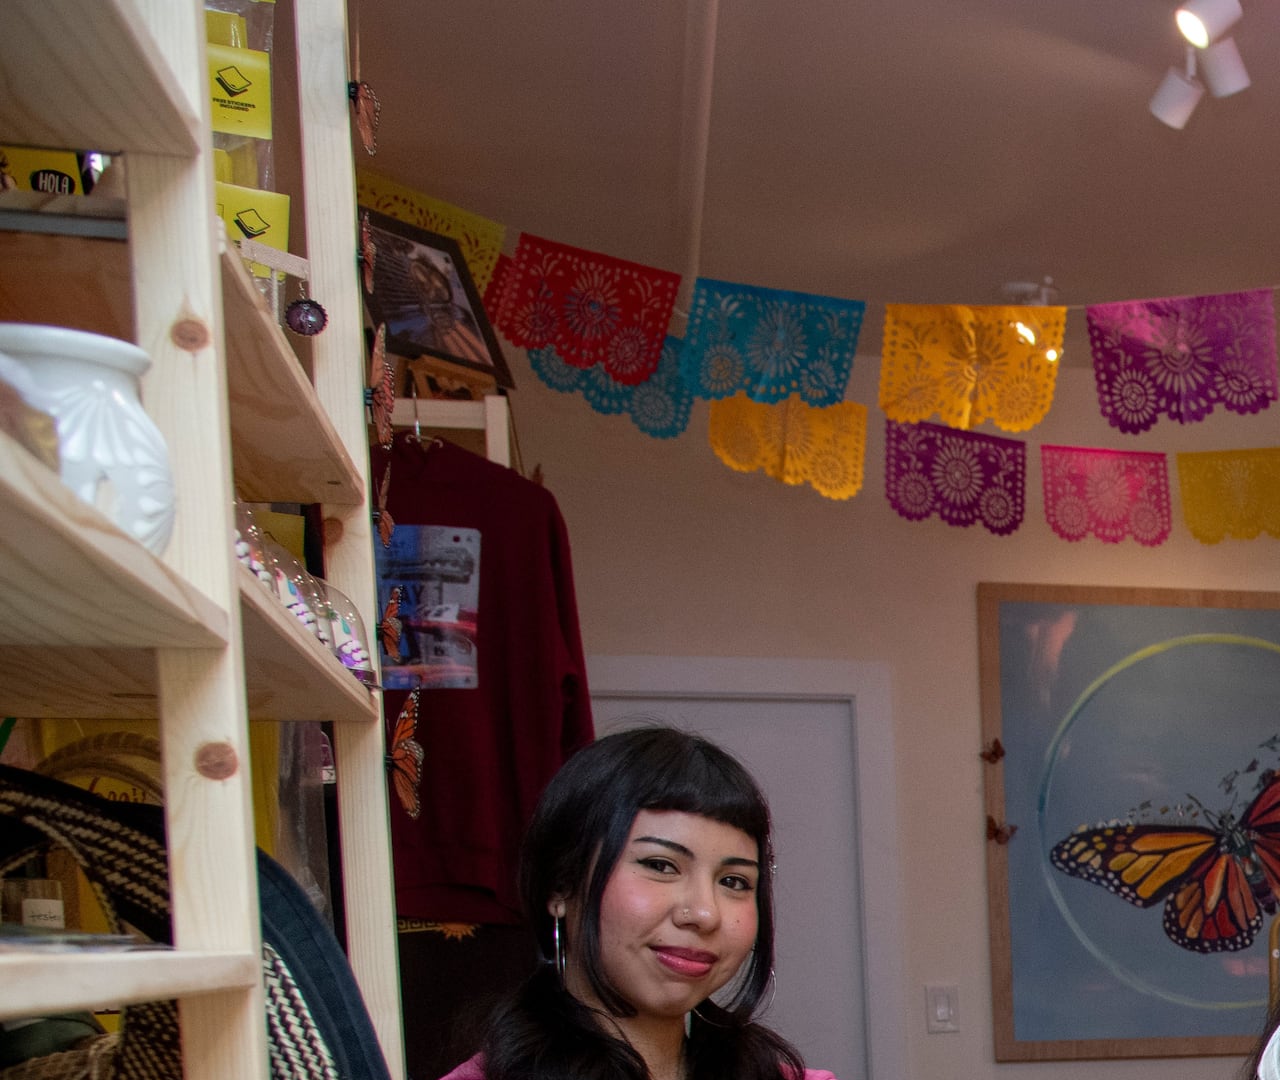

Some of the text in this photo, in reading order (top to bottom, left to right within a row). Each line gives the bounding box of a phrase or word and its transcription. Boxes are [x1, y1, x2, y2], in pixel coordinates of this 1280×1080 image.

[219, 103, 249, 112] INCLUDED
[227, 100, 256, 109] STICKERS
[38, 171, 70, 195] HOLA
